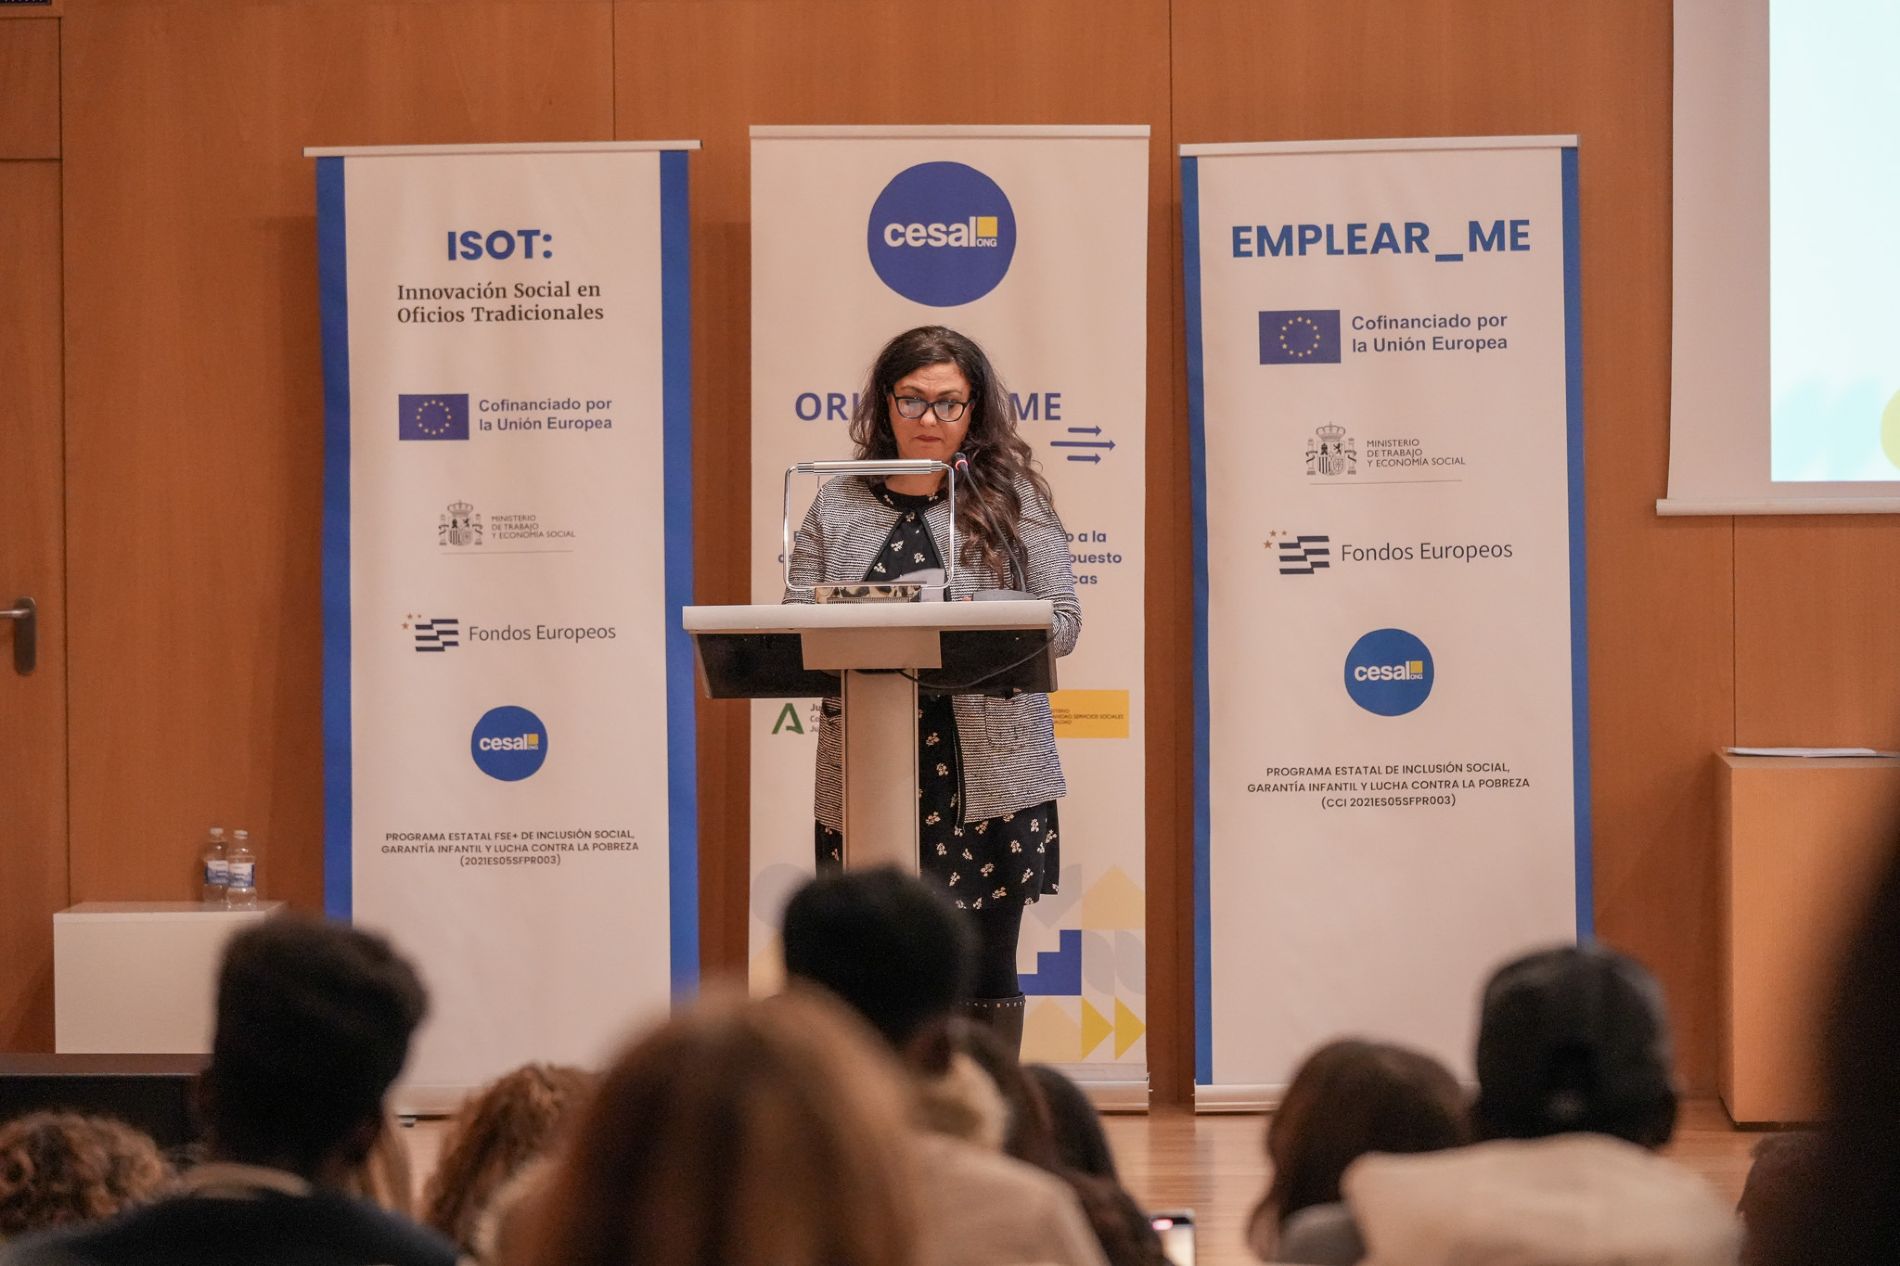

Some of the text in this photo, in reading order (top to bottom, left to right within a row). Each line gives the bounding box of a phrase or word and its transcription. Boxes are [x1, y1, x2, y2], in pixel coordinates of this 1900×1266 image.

[884, 216, 977, 248] cesal
[1231, 219, 1531, 262] EMPLEAR_ME
[447, 229, 553, 261] ISOT:
[976, 238, 998, 248] ONG
[397, 281, 601, 301] Innovación Social en
[397, 303, 604, 324] Oficios Tradicionales
[1351, 313, 1508, 332] Cofinanciado por
[1352, 335, 1508, 354] la Unión Europea
[478, 397, 613, 414] Cofinanciado por
[479, 415, 613, 432] la Unión Europea
[1366, 438, 1421, 449] MINISTERIO
[1366, 448, 1424, 459] DE TRABAJO
[1366, 460, 1374, 468] Y
[1431, 457, 1467, 467] SOCIAL
[490, 514, 537, 523] MINISTERIO
[503, 522, 540, 532] TRABAJO
[546, 530, 577, 539] SOCIAL
[1092, 529, 1107, 543] la
[1341, 542, 1513, 564] Fondos Europeos
[468, 624, 617, 644] Fondos Europeos
[1354, 660, 1410, 682] cesal
[479, 733, 528, 751] cesal
[1266, 761, 1511, 777] PROGRAMA ESTATAL DE INCLUSIÓN SOCIAL,
[1247, 777, 1531, 793] GARANTÍA INFANTIL Y LUCHA CONTRA LA POBREZA
[1321, 793, 1457, 810] (CCI 2021ES05SFPR003)
[385, 832, 446, 842] PROGRAMA
[448, 832, 493, 841] ESTATAL
[494, 831, 519, 841] FSE+
[520, 831, 534, 841] DE
[536, 828, 592, 840] INCLUSIÓN
[381, 841, 640, 854] GARANTÍA INFANTIL Y LUCHA CONTRA LA POBREZA
